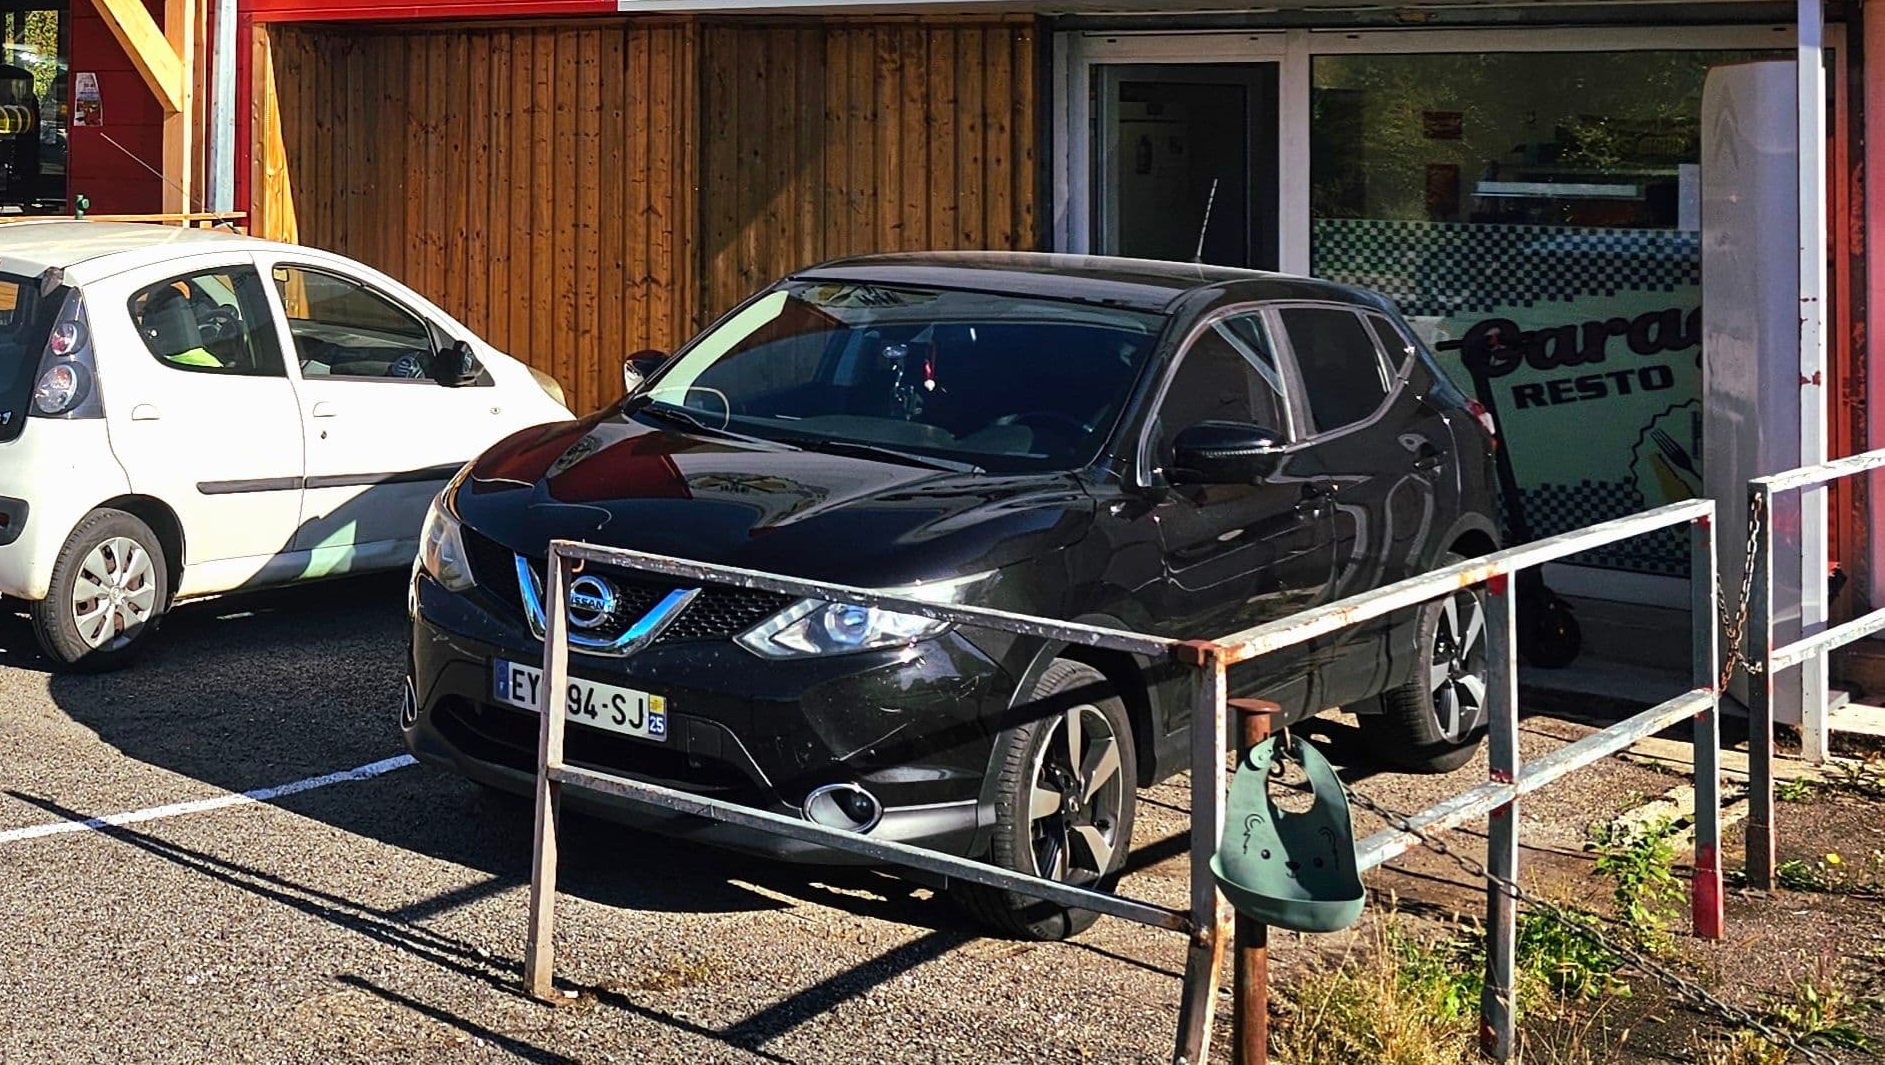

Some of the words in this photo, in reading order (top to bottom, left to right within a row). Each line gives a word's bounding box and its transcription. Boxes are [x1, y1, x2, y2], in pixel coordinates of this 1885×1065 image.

[1461, 305, 1702, 378] Gara
[1511, 365, 1674, 409] RESTO
[570, 595, 605, 610] ISSAN
[649, 715, 665, 733] 25
